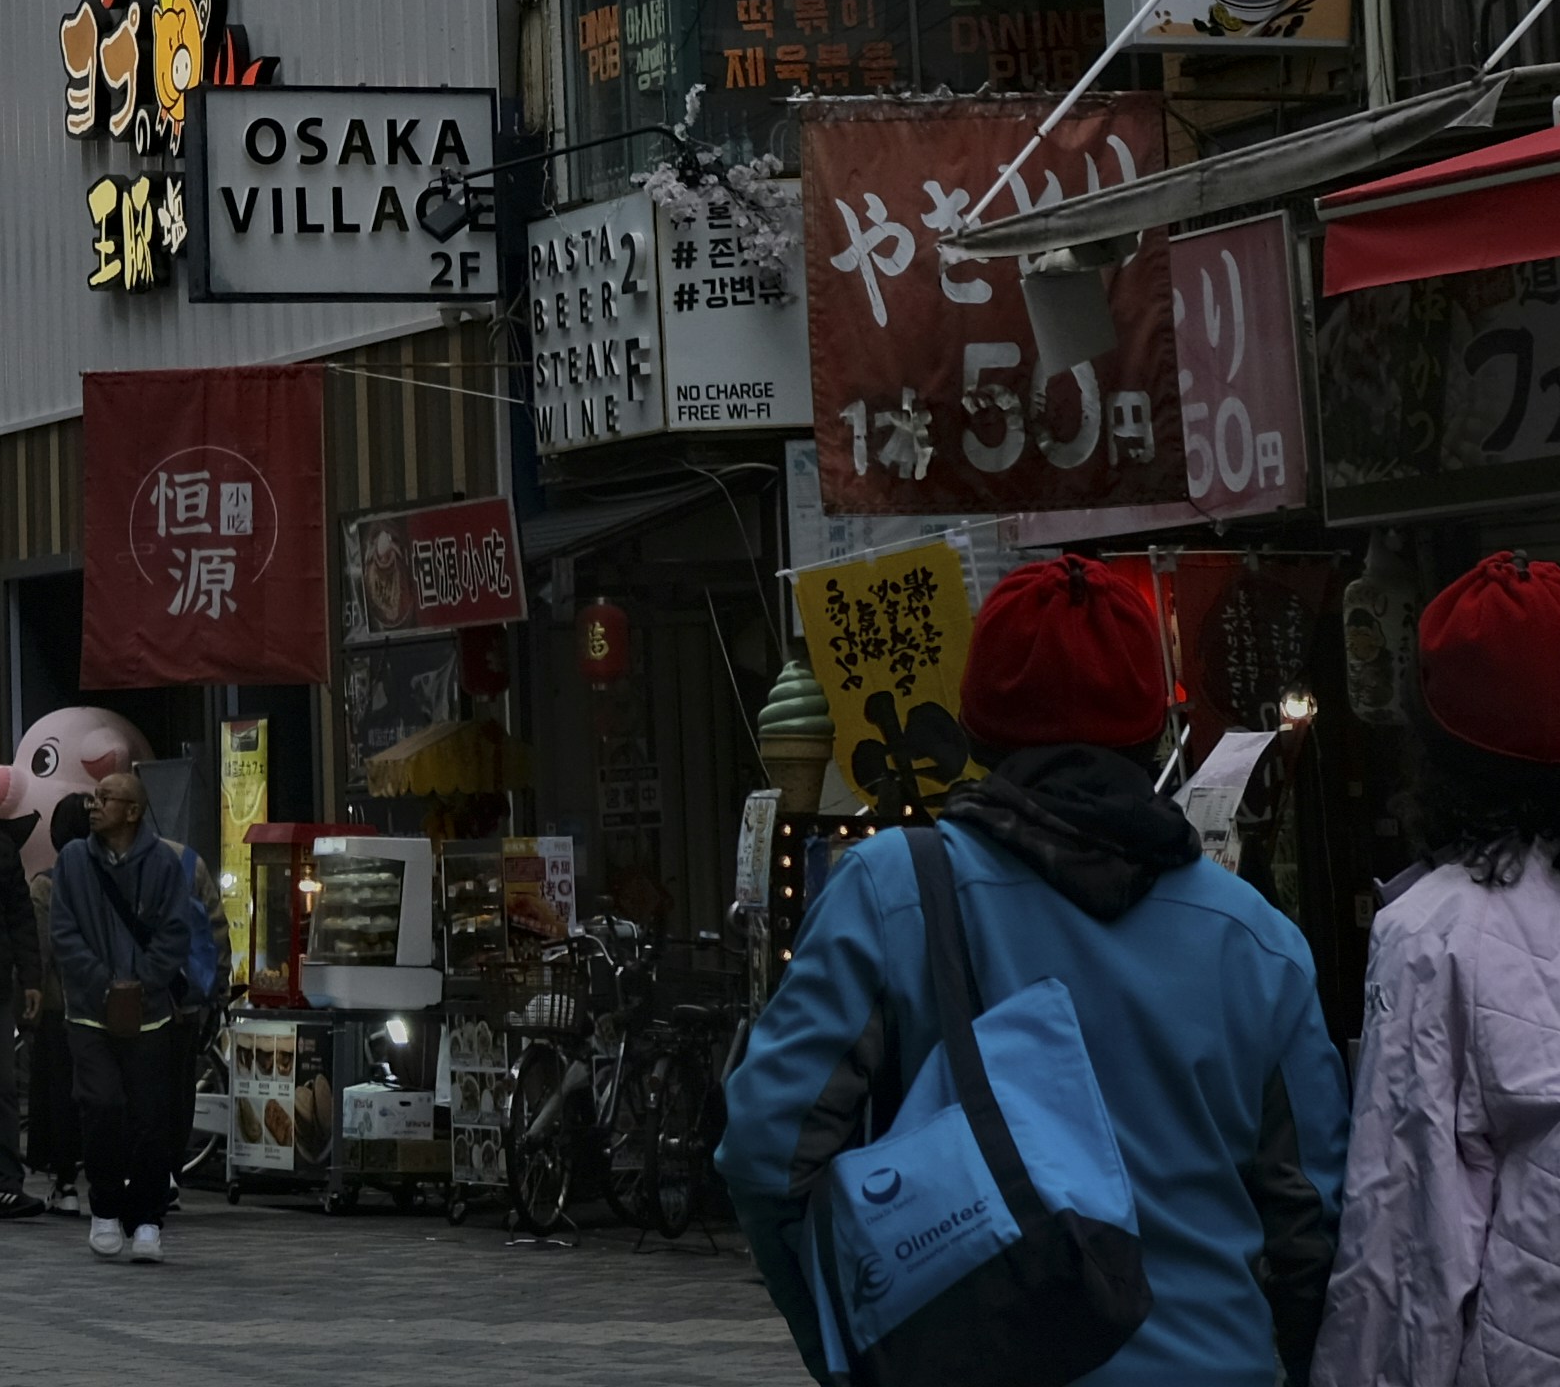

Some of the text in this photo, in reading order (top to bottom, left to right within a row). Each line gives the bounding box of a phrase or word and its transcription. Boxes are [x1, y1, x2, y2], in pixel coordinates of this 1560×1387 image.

[245, 117, 470, 166] OSAKA
[430, 252, 481, 288] 2F
[531, 224, 615, 280] PASTA
[533, 282, 618, 335] BEER
[535, 339, 619, 389] STEAK
[677, 382, 774, 402] NO CHARGE
[677, 402, 770, 421] FREE WI-FI
[536, 394, 620, 444] WINE
[150, 469, 238, 619] 恒源
[411, 528, 512, 608] 恒源小吃
[894, 1198, 988, 1261] Olmetec
